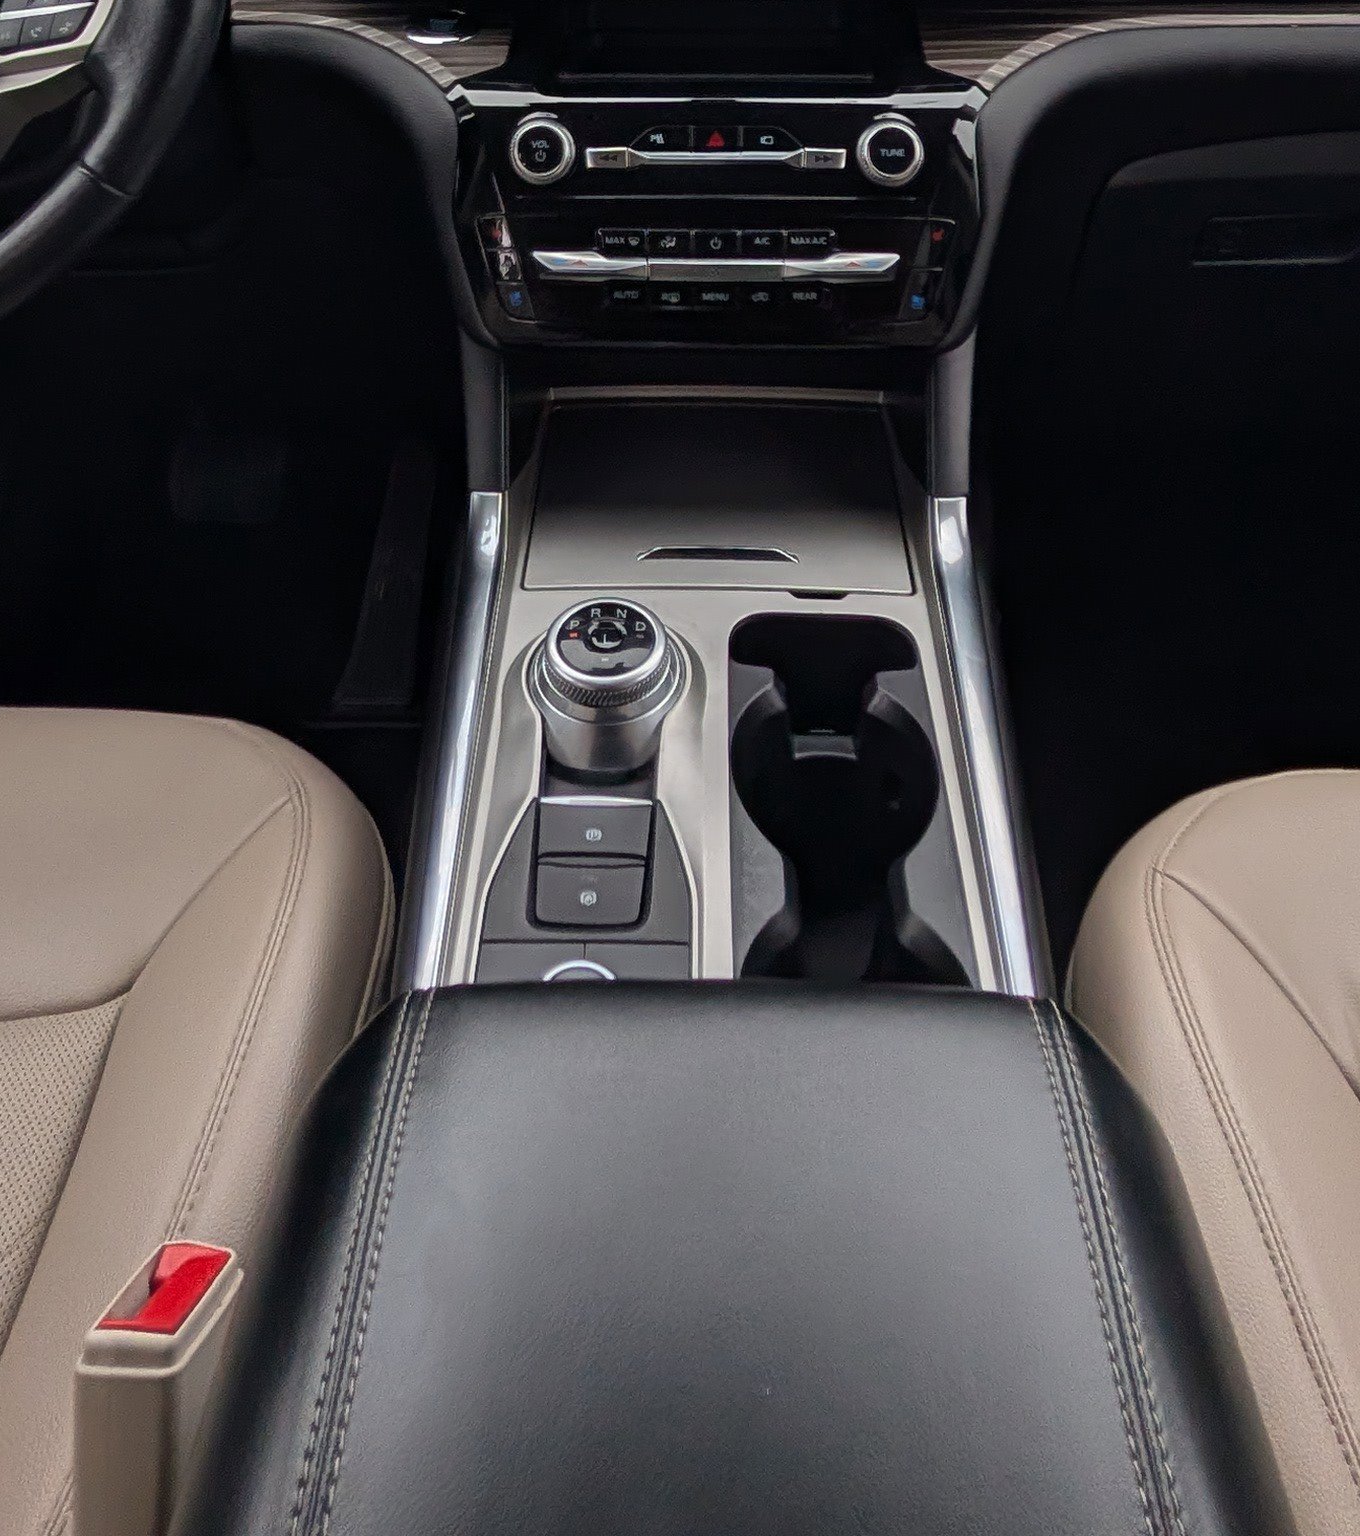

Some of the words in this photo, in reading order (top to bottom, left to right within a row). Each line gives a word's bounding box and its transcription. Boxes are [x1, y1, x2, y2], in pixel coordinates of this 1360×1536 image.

[531, 140, 550, 149] VOL
[879, 148, 906, 157] TUNE
[605, 236, 626, 244] MAX
[790, 236, 811, 245] MAX
[590, 608, 601, 618] R
[616, 608, 628, 619] N
[569, 619, 580, 631] P
[635, 621, 647, 632] D
